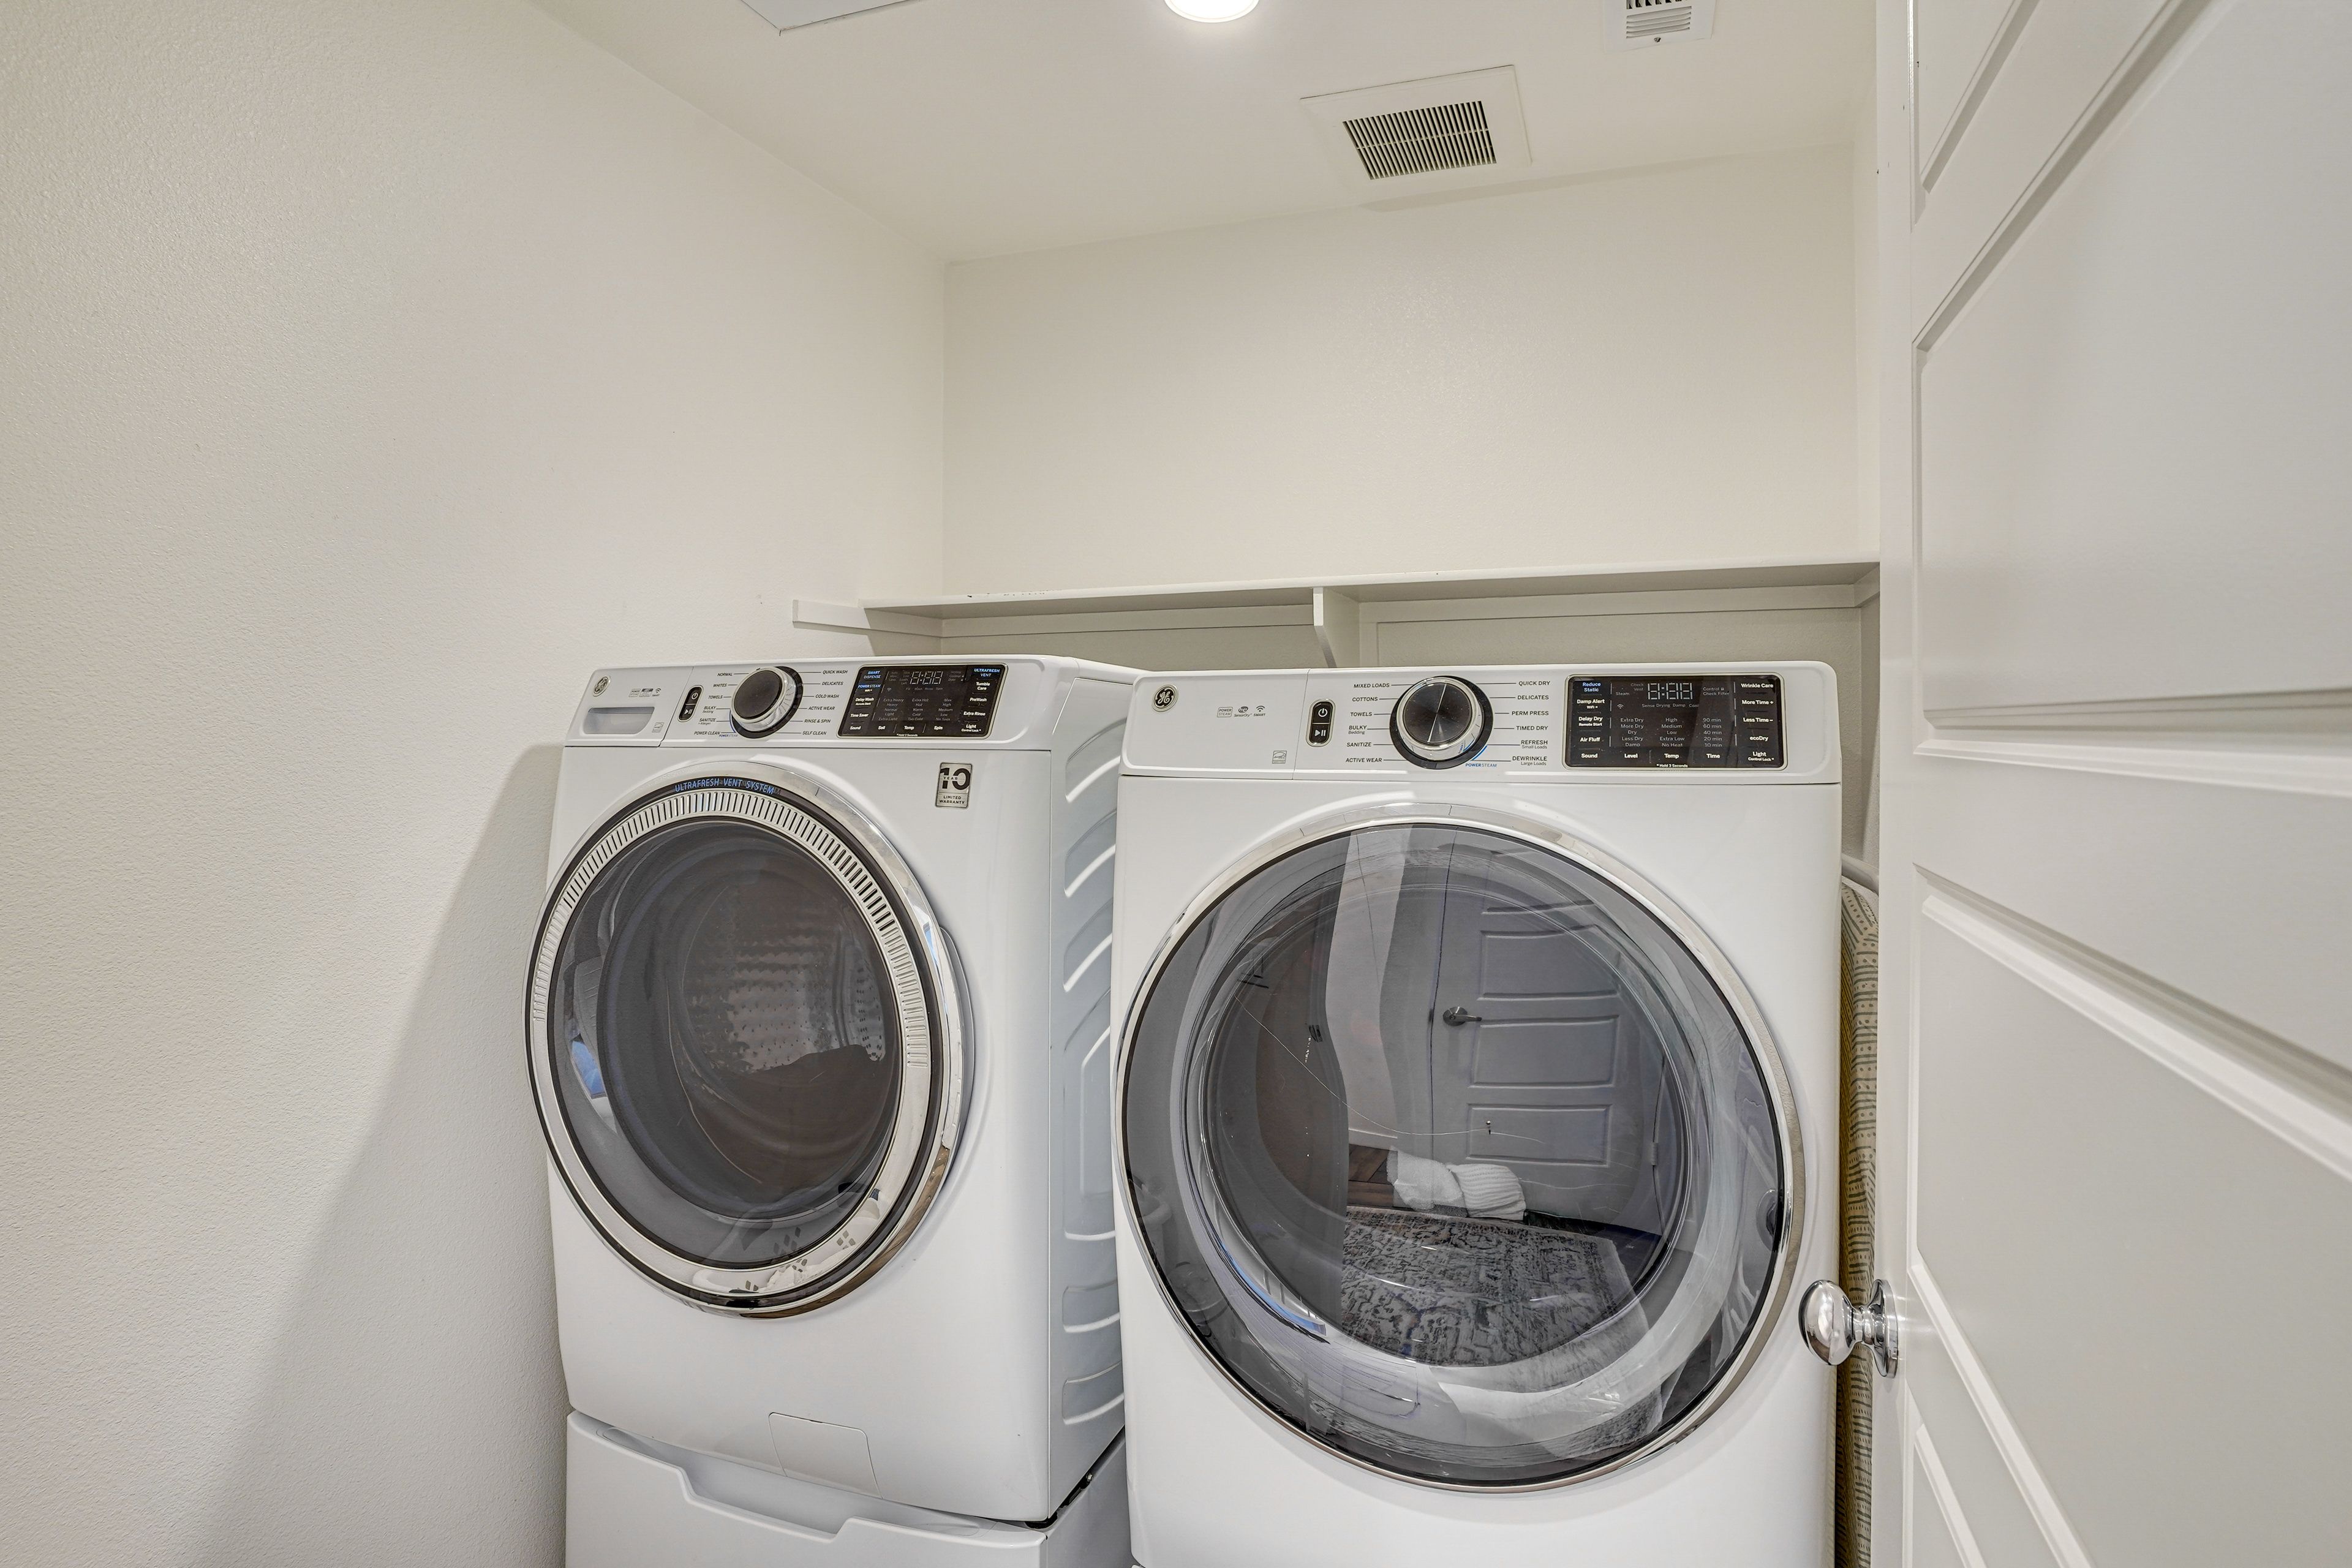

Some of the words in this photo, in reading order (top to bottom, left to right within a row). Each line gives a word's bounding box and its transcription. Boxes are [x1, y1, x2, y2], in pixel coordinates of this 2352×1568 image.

[675, 778, 720, 792] ULTRAFRESH
[723, 778, 742, 787] VENT
[745, 780, 775, 794] SYSTEM
[940, 767, 971, 790] 10
